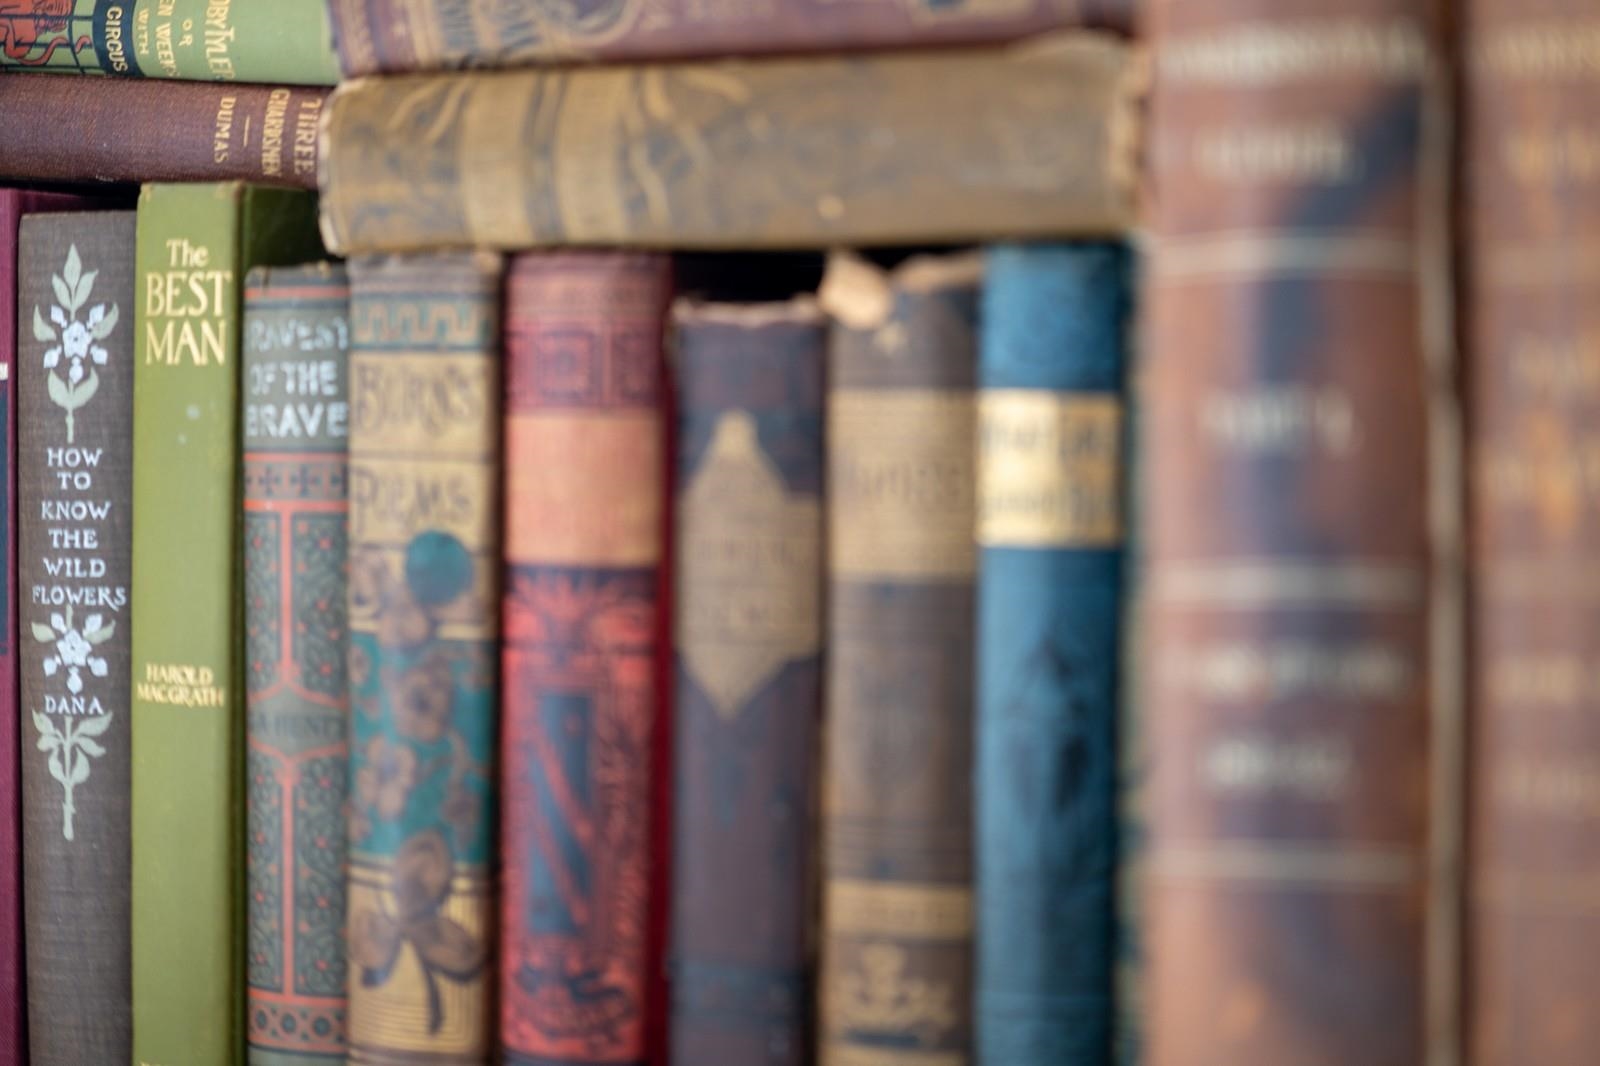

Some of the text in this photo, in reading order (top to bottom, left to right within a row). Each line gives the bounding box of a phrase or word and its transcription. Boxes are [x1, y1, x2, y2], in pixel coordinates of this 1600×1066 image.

[158, 0, 176, 16] EN
[105, 6, 128, 72] CIRCUS
[138, 8, 150, 55] WITH
[178, 18, 193, 47] OR
[214, 96, 236, 163] DUMAS
[294, 97, 322, 175] THREE
[166, 238, 208, 267] The
[145, 270, 233, 317] BEST
[145, 319, 227, 366] MAN
[280, 359, 338, 396] THE
[246, 400, 348, 438] BRAVE
[47, 447, 102, 468] HOW
[57, 471, 92, 490] TO
[41, 500, 111, 520] KNOW
[48, 528, 98, 549] THE
[43, 557, 106, 578] WILD
[32, 585, 126, 611] FLOWERS
[146, 664, 213, 686] HAROLD
[44, 696, 104, 715] DANA
